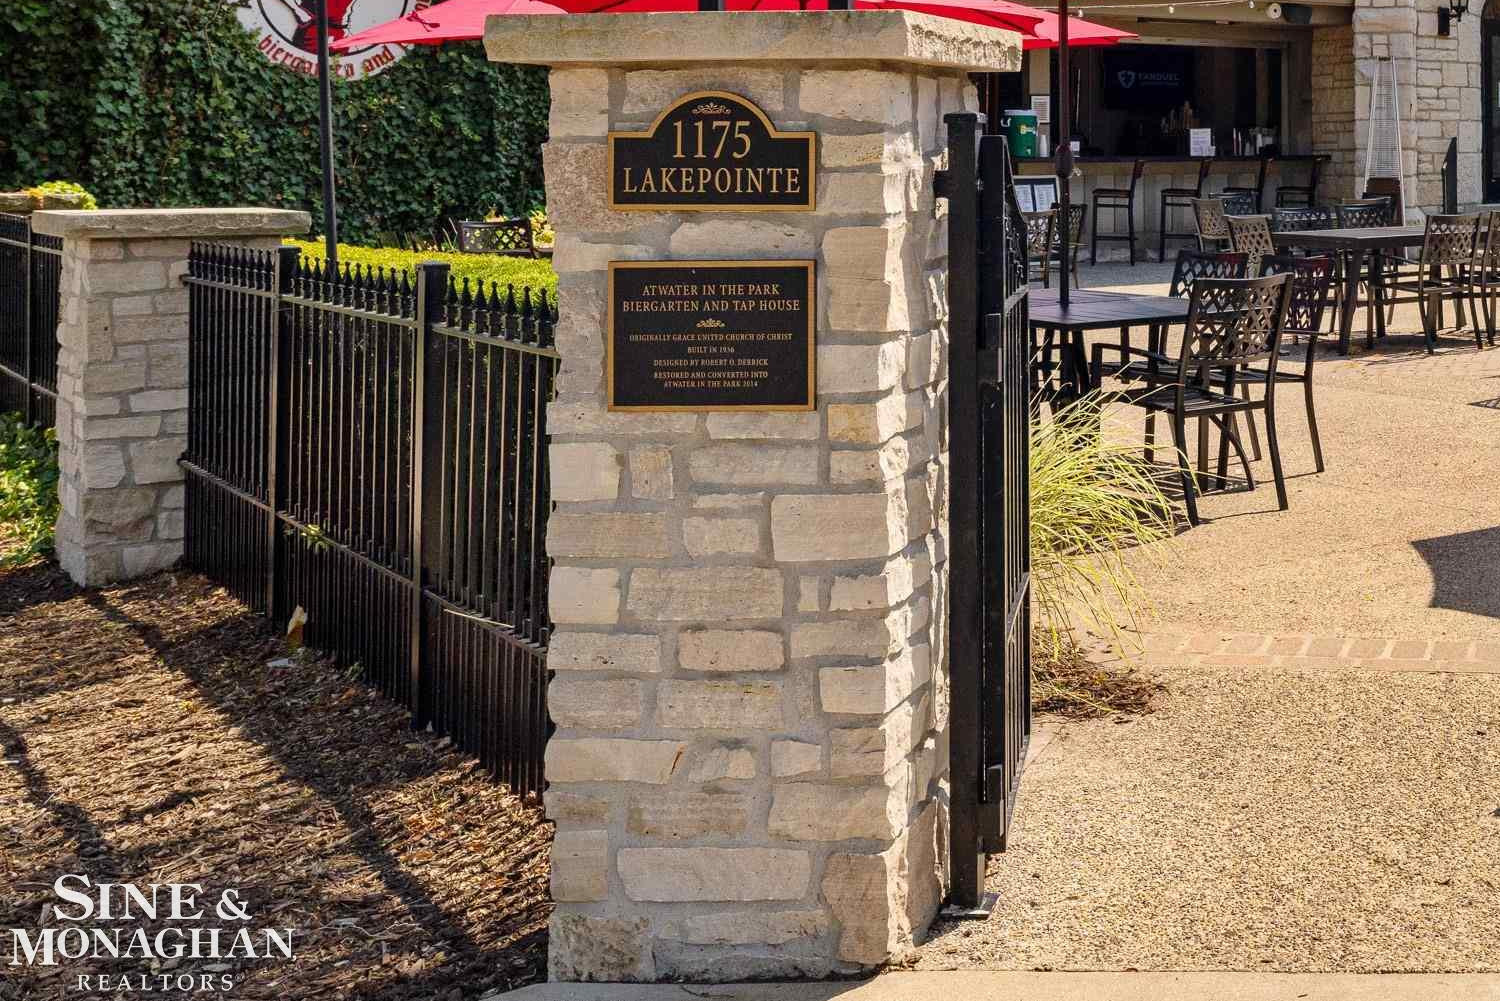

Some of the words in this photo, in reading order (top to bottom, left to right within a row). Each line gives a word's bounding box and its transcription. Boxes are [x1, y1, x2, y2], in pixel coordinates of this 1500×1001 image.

[361, 43, 396, 74] and
[673, 120, 752, 159] 1175
[622, 167, 801, 194] LAKEPOINTE
[642, 285, 698, 296] ATWATER
[702, 285, 715, 295] IN
[719, 284, 744, 295] THE
[748, 284, 780, 295] PARK
[622, 301, 699, 313] BIERGARTEN
[703, 301, 729, 312] AND
[733, 300, 756, 311] TAP
[759, 299, 801, 311] HOUSE
[629, 334, 671, 343] ORIGINALLY
[672, 333, 697, 342] GRACE
[698, 333, 724, 341] UNITED
[725, 333, 755, 341] CHURCH
[756, 333, 766, 341] OF
[767, 332, 793, 341] CHRIST
[687, 346, 707, 354] BUILT
[653, 359, 688, 367] DESIGNED
[689, 359, 699, 367] BY
[700, 358, 728, 366] ROBERT
[653, 371, 689, 379] RESTORED
[707, 371, 750, 379] CONVERTED
[751, 371, 769, 379] INTO
[663, 380, 695, 389] ATWATER
[697, 380, 705, 388] IN
[707, 380, 721, 388] THE
[722, 380, 741, 388] PARK
